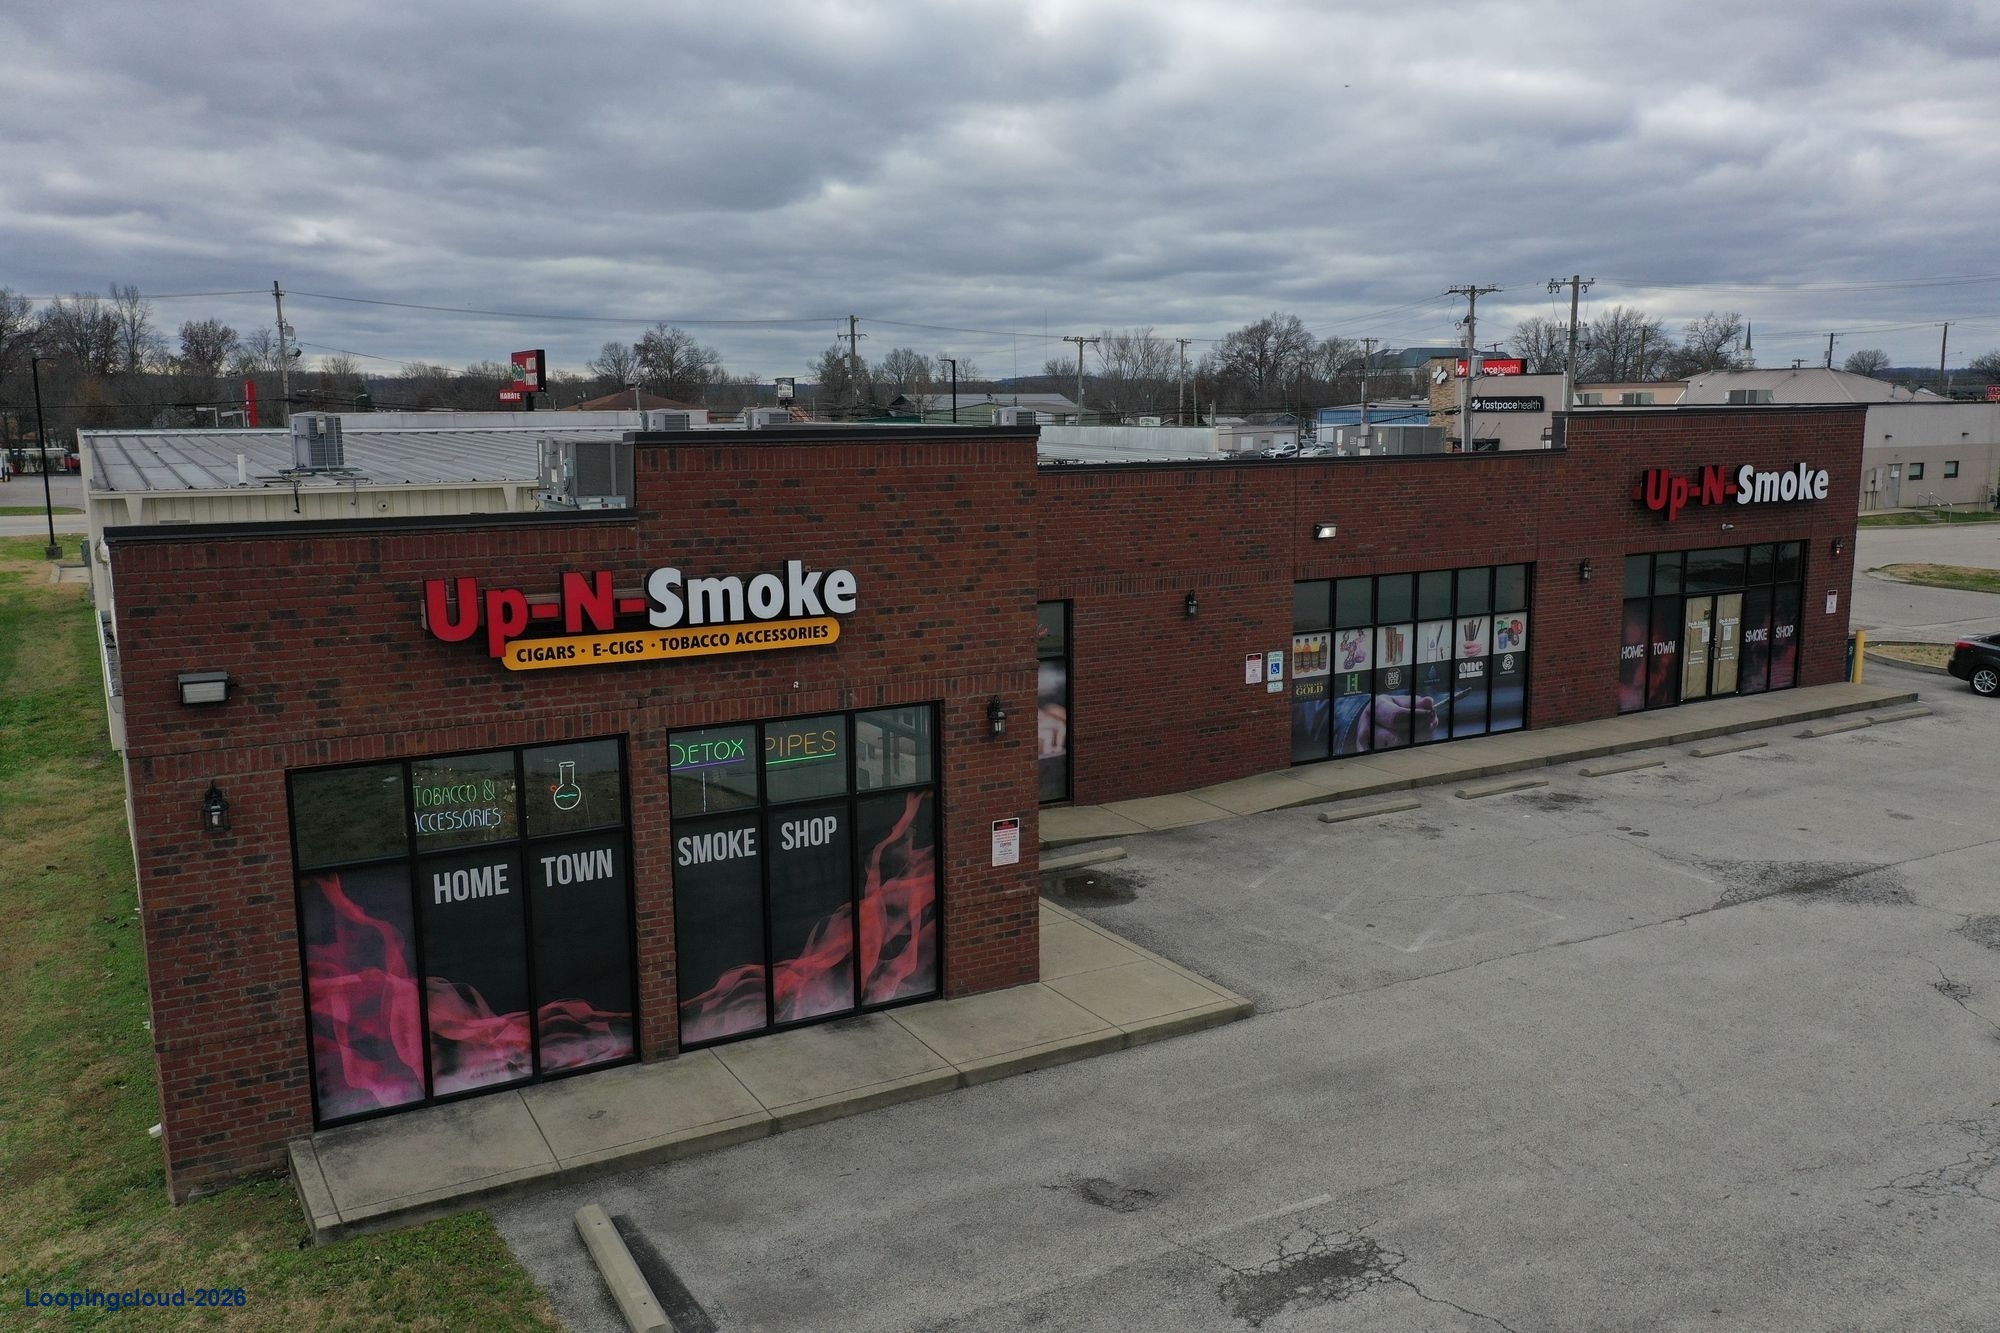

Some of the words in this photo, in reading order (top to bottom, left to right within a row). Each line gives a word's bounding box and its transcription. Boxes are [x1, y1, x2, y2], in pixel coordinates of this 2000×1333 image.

[1646, 462, 1829, 521] Up-N-Smoke
[424, 559, 857, 658] Up-N-Smoke
[516, 644, 576, 663] CIGARS
[593, 639, 644, 657] E-CIGS
[660, 632, 730, 651] TOBACCO
[735, 624, 829, 646] ACCESSORIES
[1745, 628, 1768, 643] SMOKE
[1775, 624, 1794, 639] SHOP
[1621, 643, 1644, 660] HOME
[1653, 640, 1676, 656] TOWN
[1295, 685, 1324, 696] GOLD
[669, 738, 745, 767] DETOX
[765, 729, 837, 757] PIPES
[412, 784, 477, 808] TOBACCO
[483, 778, 496, 801] &
[677, 827, 757, 867] SMOKE
[781, 815, 837, 851] SHOP
[433, 863, 510, 905] HOME
[540, 848, 613, 888] TOWN
